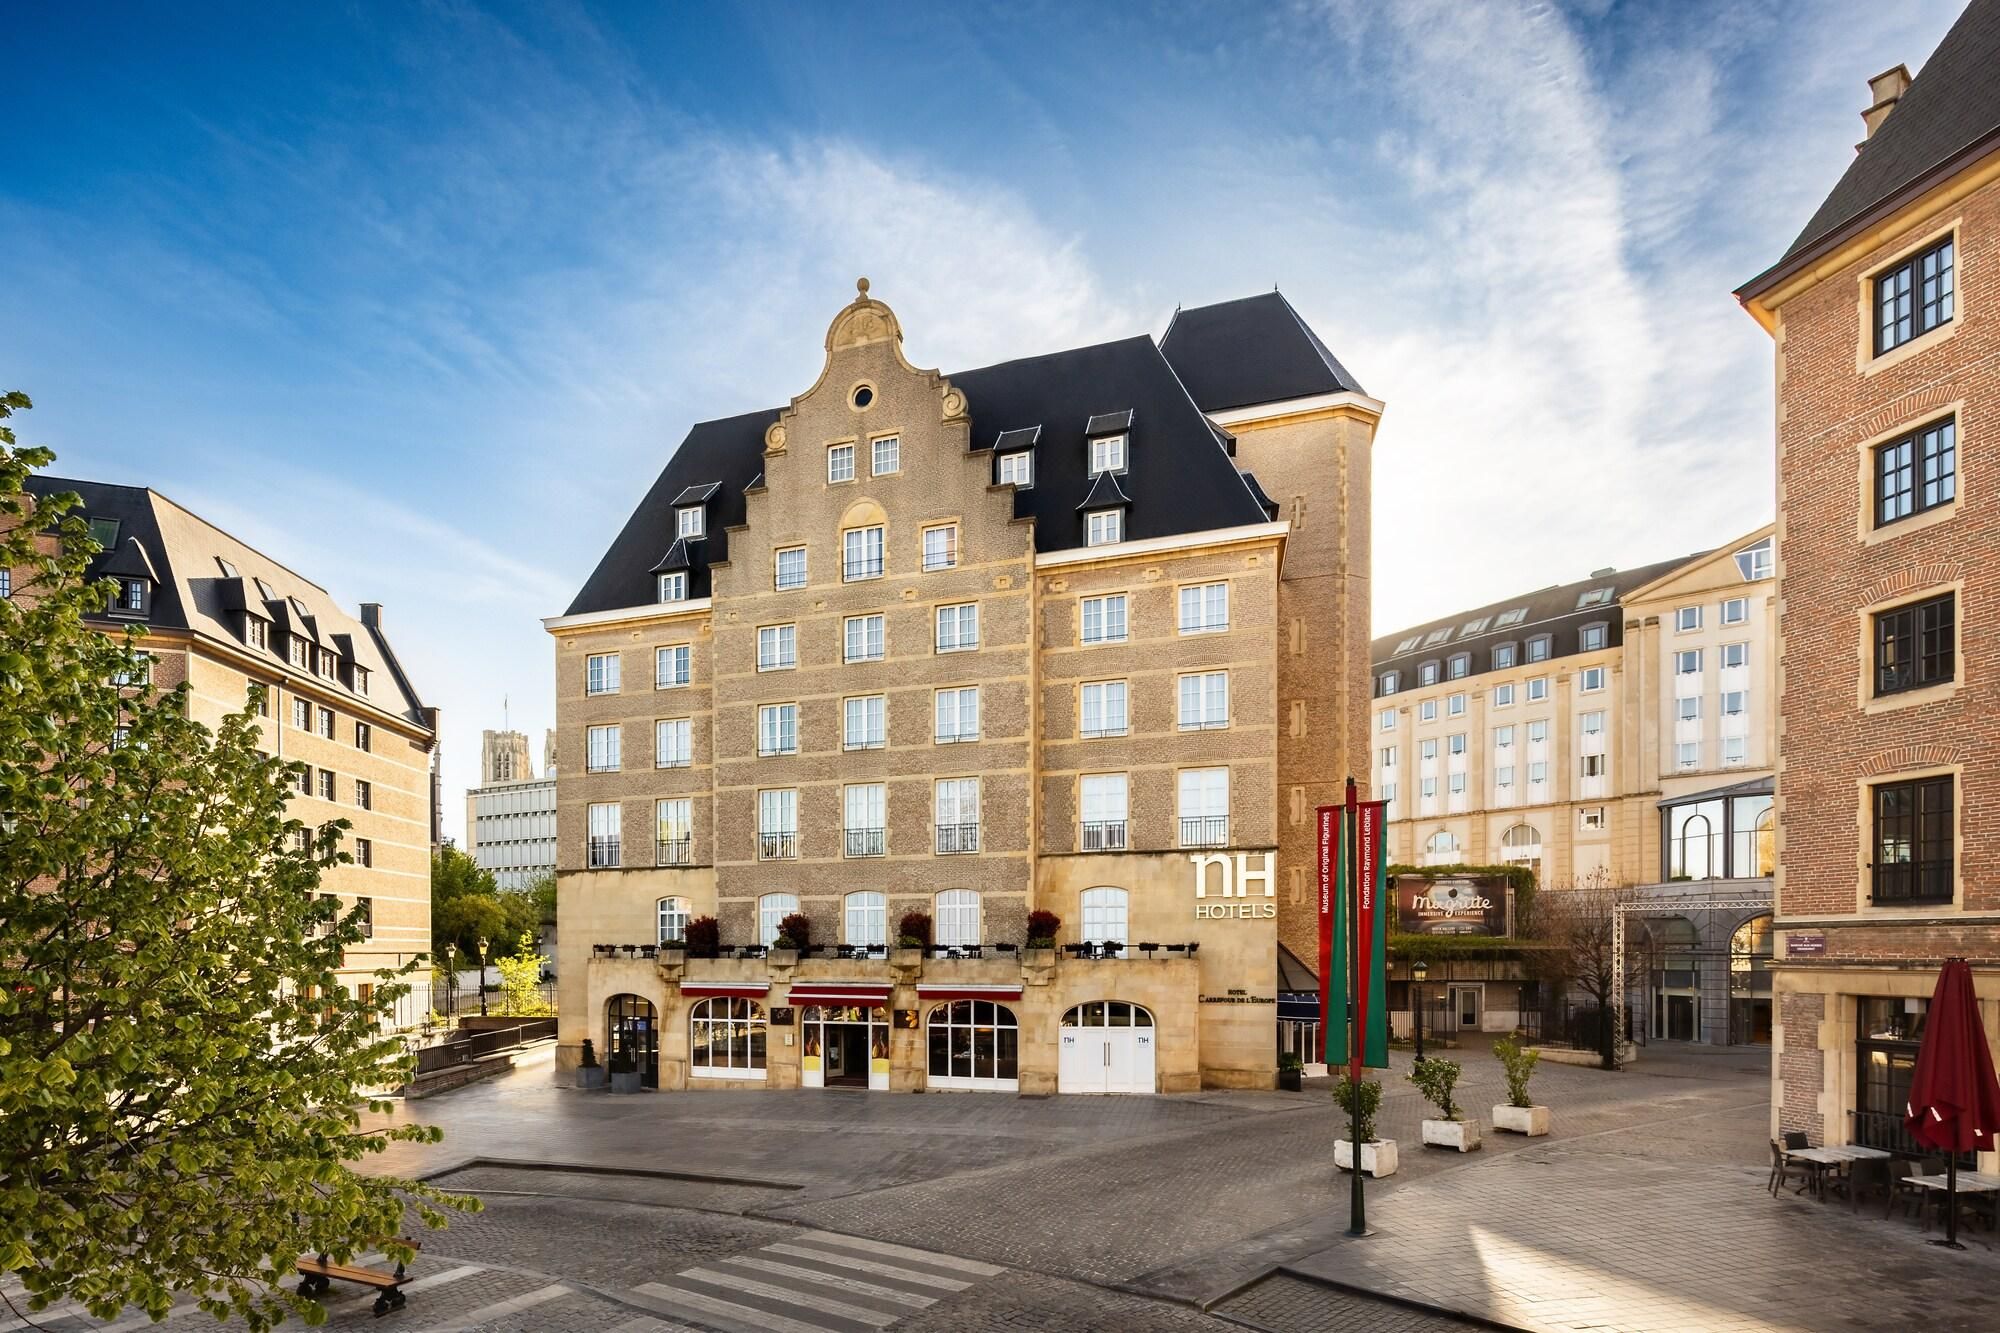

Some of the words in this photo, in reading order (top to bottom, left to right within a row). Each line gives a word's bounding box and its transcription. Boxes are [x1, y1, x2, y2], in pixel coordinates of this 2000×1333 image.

[1322, 812, 1331, 845] Figurines
[1363, 808, 1372, 836] Leblanc
[1322, 846, 1330, 873] Original
[1363, 837, 1372, 871] Raymond
[1322, 880, 1330, 913] Museum
[1363, 872, 1372, 909] Fondation
[1196, 903, 1276, 919] HOTELS
